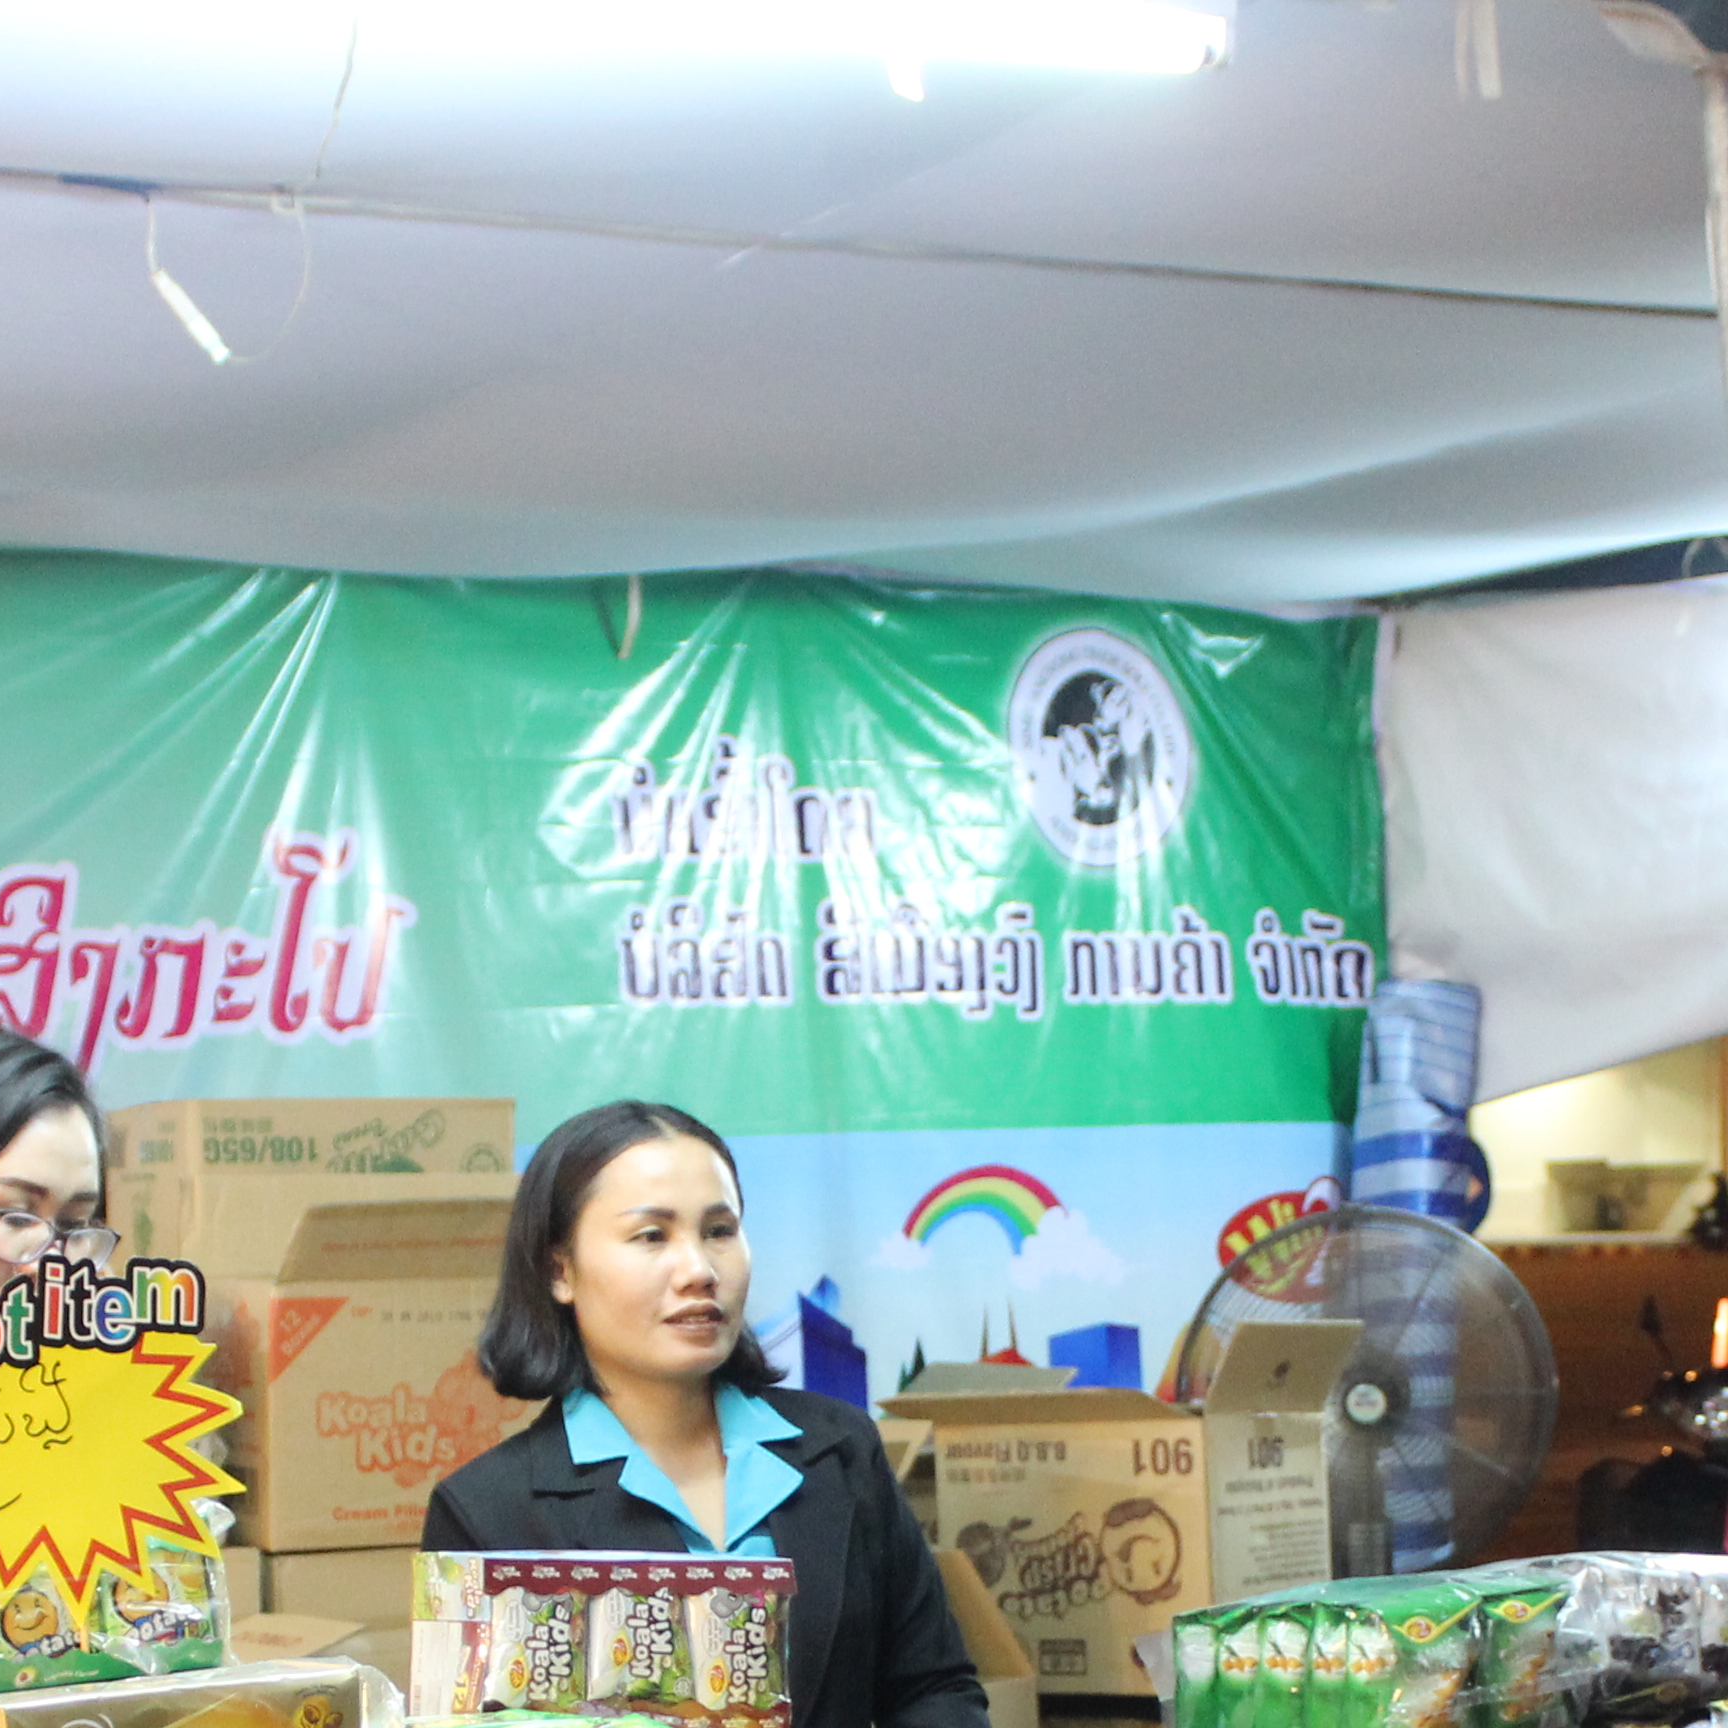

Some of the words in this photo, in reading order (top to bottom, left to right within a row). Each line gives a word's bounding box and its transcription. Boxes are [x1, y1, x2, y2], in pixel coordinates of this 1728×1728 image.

[1071, 913, 1227, 997] ການຄ້າ
[1252, 914, 1366, 1000] ຈຳກັດ
[204, 1135, 318, 1164] 108/65G
[42, 1261, 201, 1348] item
[319, 1384, 428, 1436] Koala
[357, 1424, 457, 1471] Kids
[1130, 1438, 1195, 1478] 901
[526, 1624, 551, 1702] Koala
[626, 1601, 653, 1679] Koala
[723, 1627, 748, 1705] Koala
